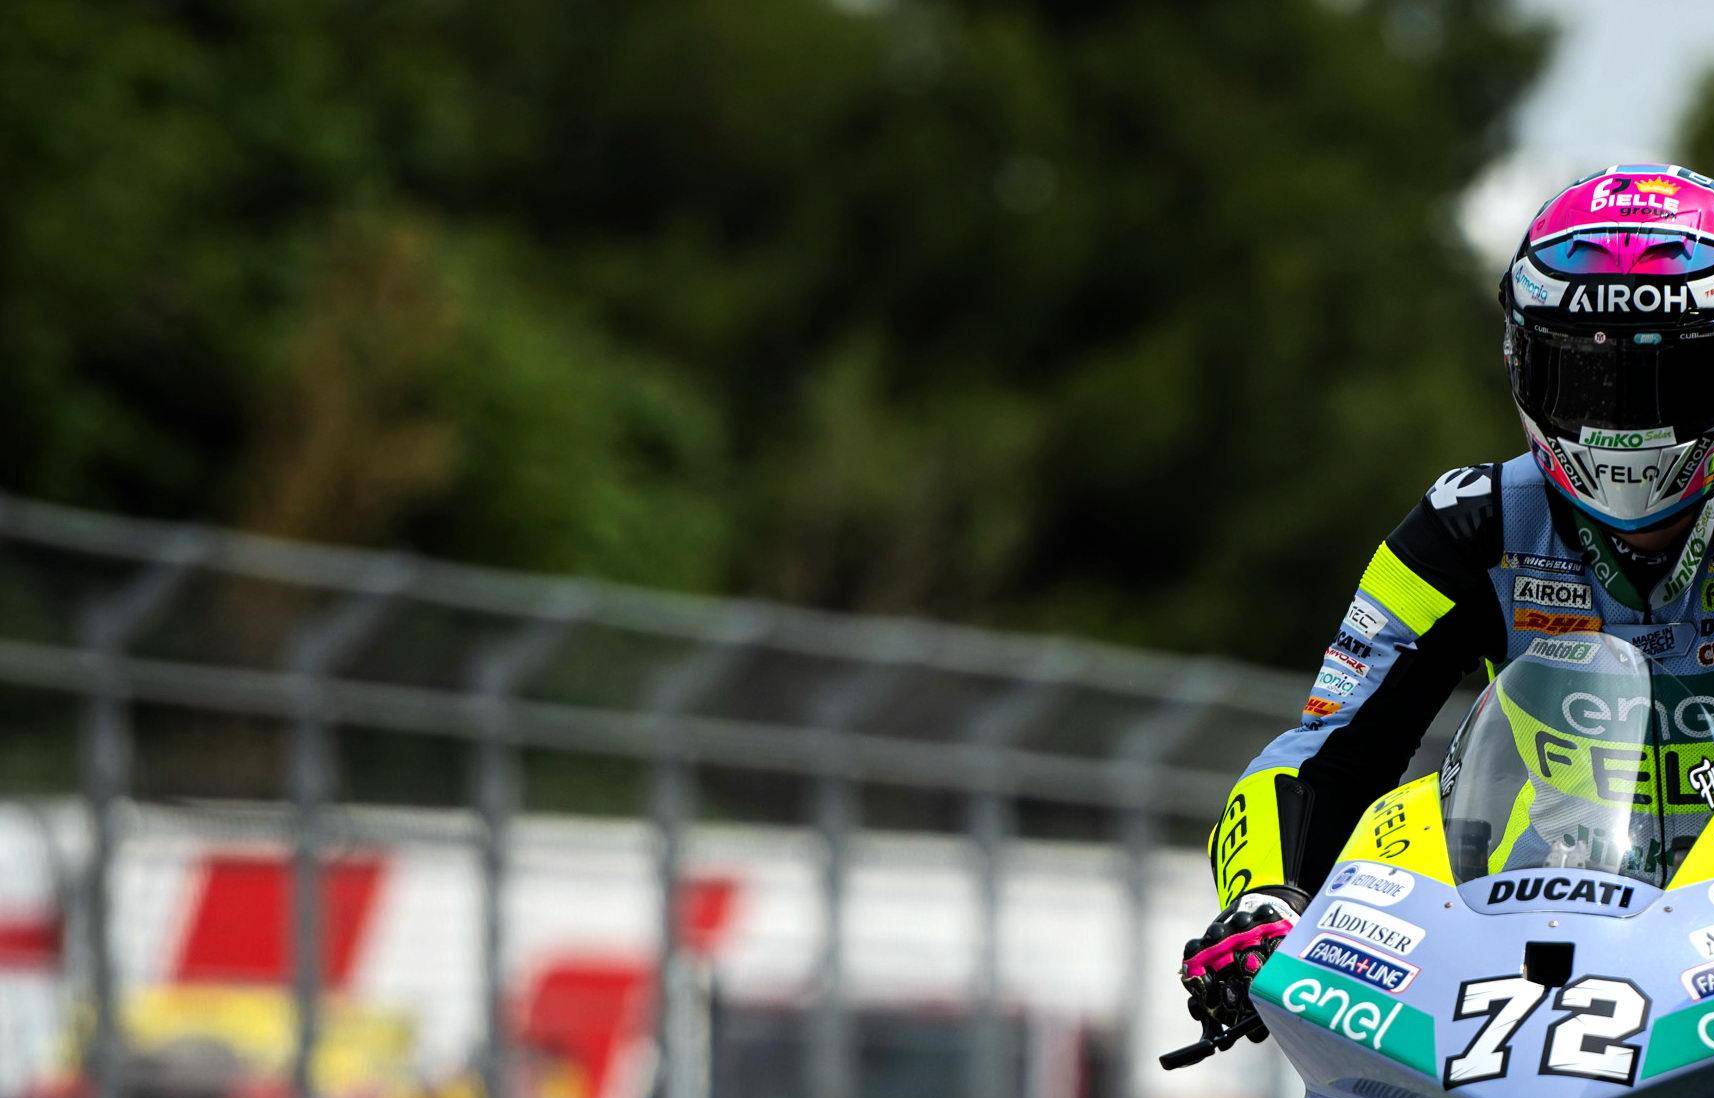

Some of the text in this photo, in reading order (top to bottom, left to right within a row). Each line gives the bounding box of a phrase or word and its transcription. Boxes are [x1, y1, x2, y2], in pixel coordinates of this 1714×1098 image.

[1590, 194, 1680, 214] DIELLE
[1569, 284, 1687, 312] AIROH
[1547, 437, 1582, 487] AIROH
[1676, 437, 1710, 488] AIROH
[1523, 556, 1582, 572] MICHELIN
[1578, 528, 1618, 588] enel
[1519, 581, 1587, 605] AIROH
[1523, 612, 1594, 634] DHL
[1487, 877, 1634, 908] DUCATI
[1321, 905, 1412, 953] ADDVISER
[1283, 978, 1403, 1049] enel
[1443, 974, 1653, 1091] 72
